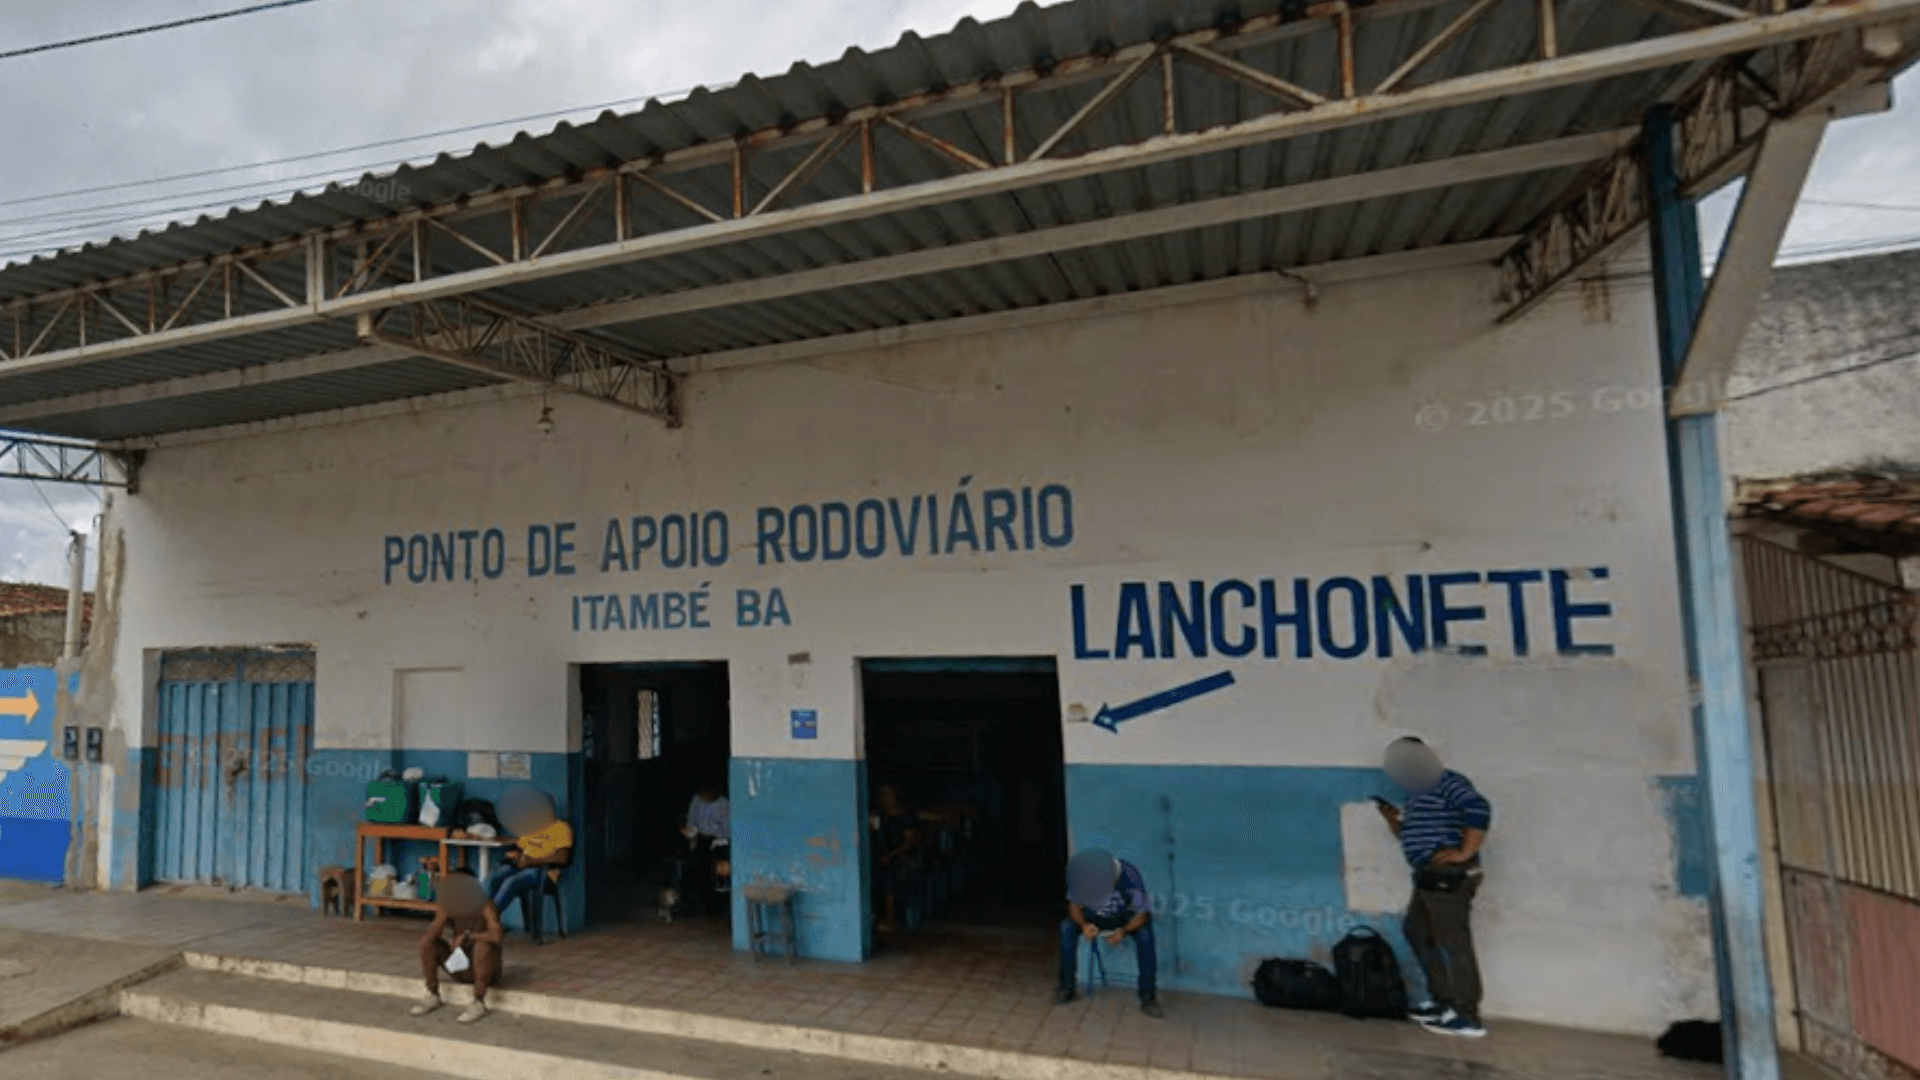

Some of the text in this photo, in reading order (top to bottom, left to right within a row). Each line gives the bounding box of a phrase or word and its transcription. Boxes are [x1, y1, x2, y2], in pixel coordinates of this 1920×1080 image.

[384, 474, 1074, 585] PONTO DE APOIO RODOVIÁRIO
[571, 581, 792, 631] ITAMBÉ BA
[1070, 566, 1615, 661] LANCHONETE
